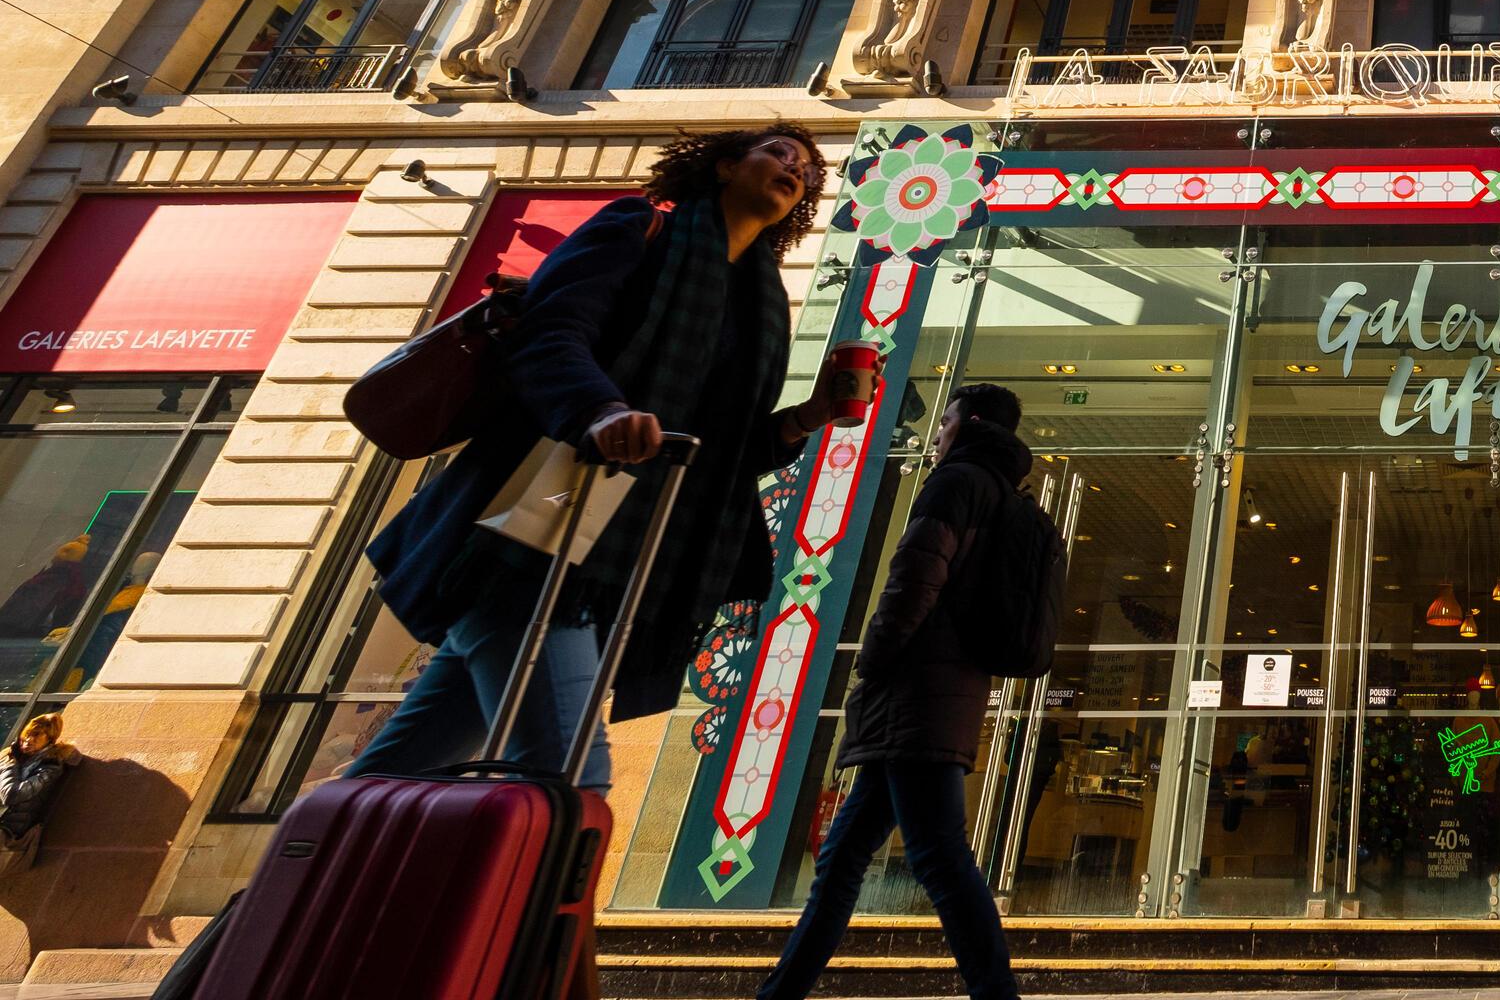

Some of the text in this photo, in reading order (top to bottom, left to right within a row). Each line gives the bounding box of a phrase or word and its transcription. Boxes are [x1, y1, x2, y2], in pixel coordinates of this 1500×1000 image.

[1006, 46, 1104, 107] LA
[18, 328, 257, 351] GALERIES LAFAYETTE
[1047, 690, 1074, 698] POUSSEZ
[1297, 689, 1324, 697] POUSSEZ
[1369, 688, 1397, 697] POUSSEZ
[1046, 698, 1062, 706] PUSH
[1307, 697, 1324, 705] PUSH
[1369, 697, 1386, 705] PUSH
